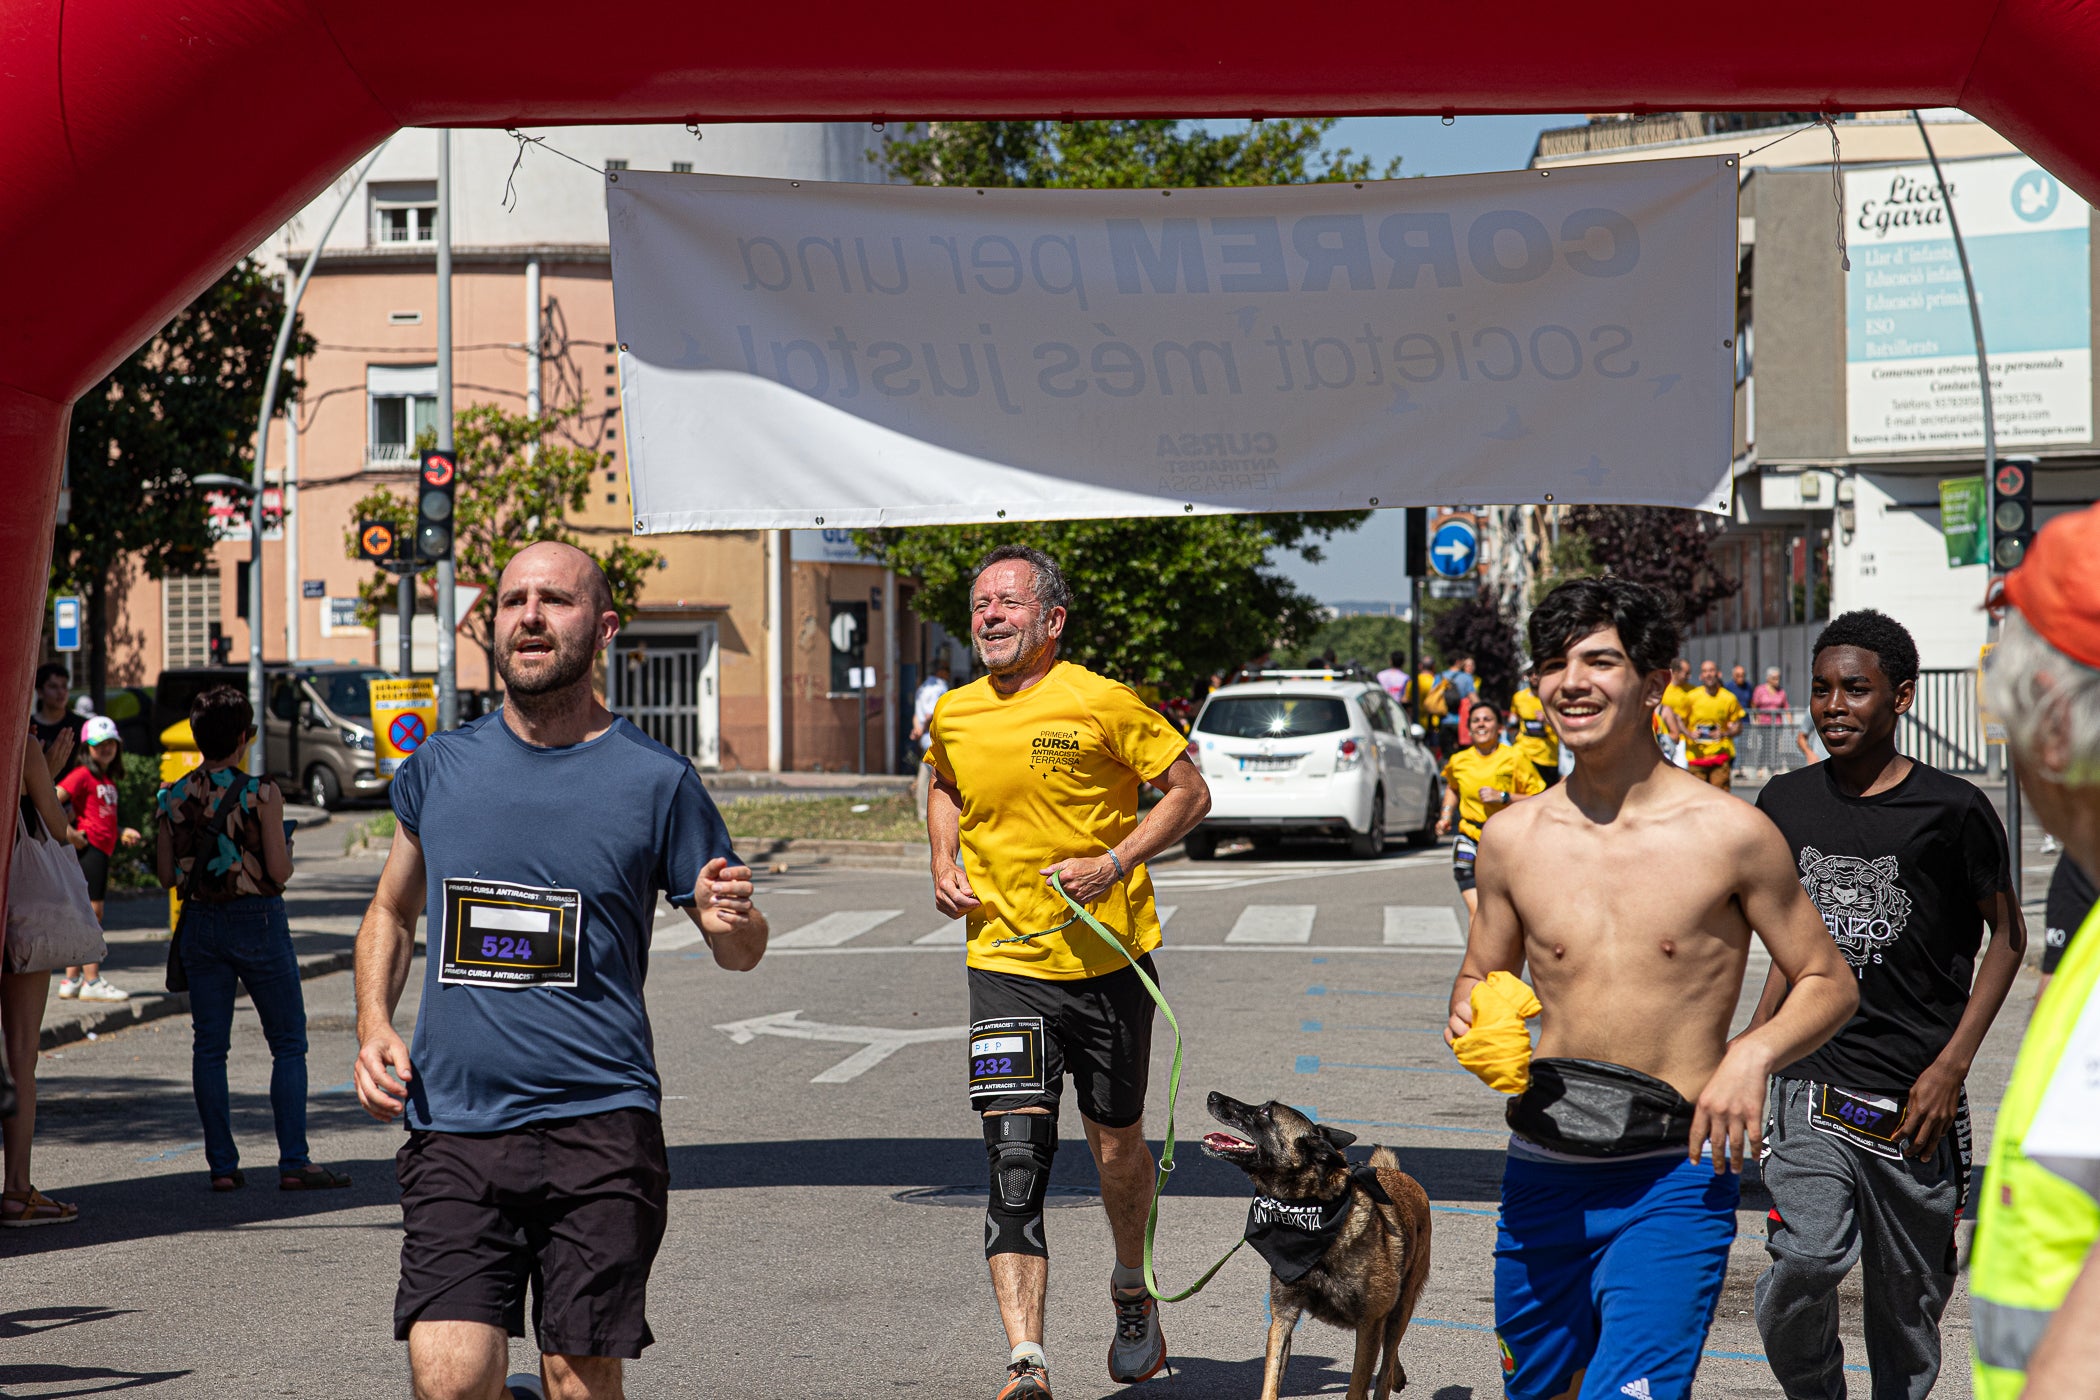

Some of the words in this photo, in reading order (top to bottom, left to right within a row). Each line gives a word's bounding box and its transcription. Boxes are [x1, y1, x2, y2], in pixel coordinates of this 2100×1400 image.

[1858, 199, 1943, 238] Egara
[1865, 318, 1895, 336] ESO
[1031, 737, 1080, 750] CURSA
[1040, 730, 1073, 739] PRIMERA
[1031, 755, 1080, 765] TERRASSA
[472, 886, 495, 895] CURSA
[1822, 913, 1891, 940] ENZO
[481, 935, 532, 960] 524
[467, 969, 492, 979] CURSA
[975, 1057, 1012, 1076] 232
[1839, 1101, 1884, 1129] 467
